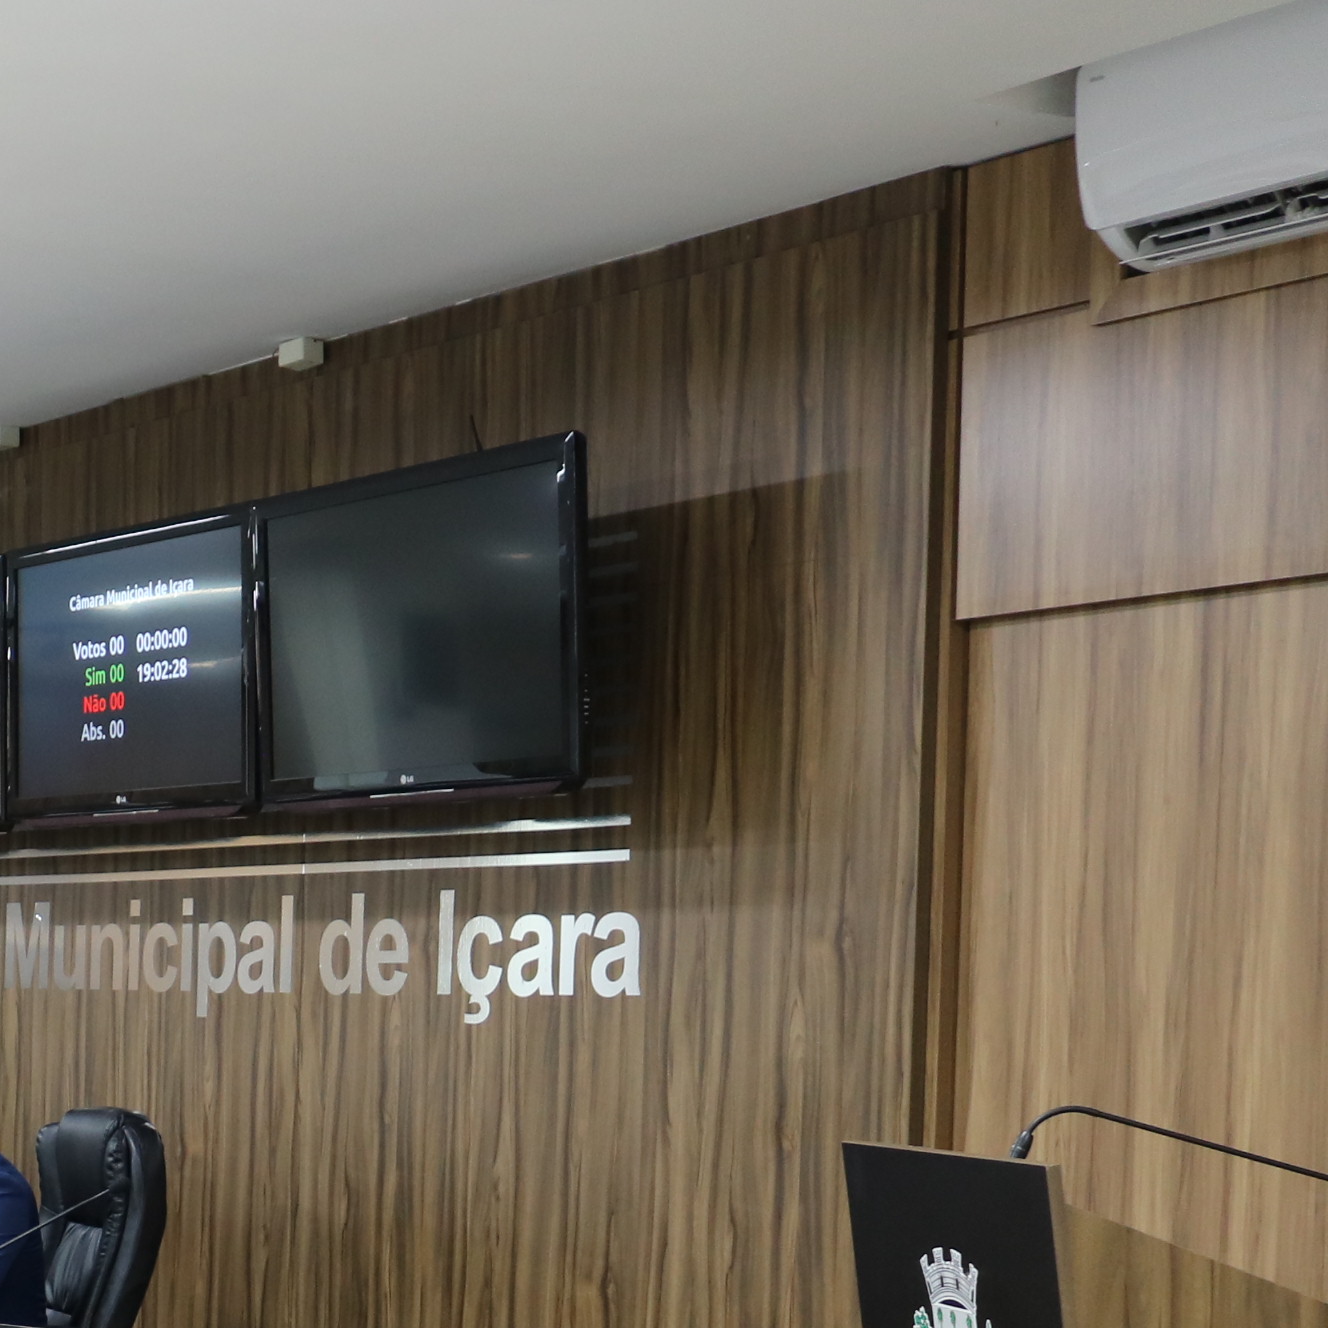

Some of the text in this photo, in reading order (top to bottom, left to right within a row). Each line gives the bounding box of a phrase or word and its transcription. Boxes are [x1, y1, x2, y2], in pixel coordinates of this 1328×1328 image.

[70, 578, 194, 611] Câmara Municipal de Içara
[73, 627, 187, 660] Votos 00 00:00:00
[85, 658, 187, 687] Sim 00 19:02:28
[83, 691, 125, 714] Não 00
[81, 719, 124, 742] Abs. 00
[5, 895, 294, 1018] Municipal
[319, 893, 409, 997] de
[437, 889, 641, 1025] Içara
